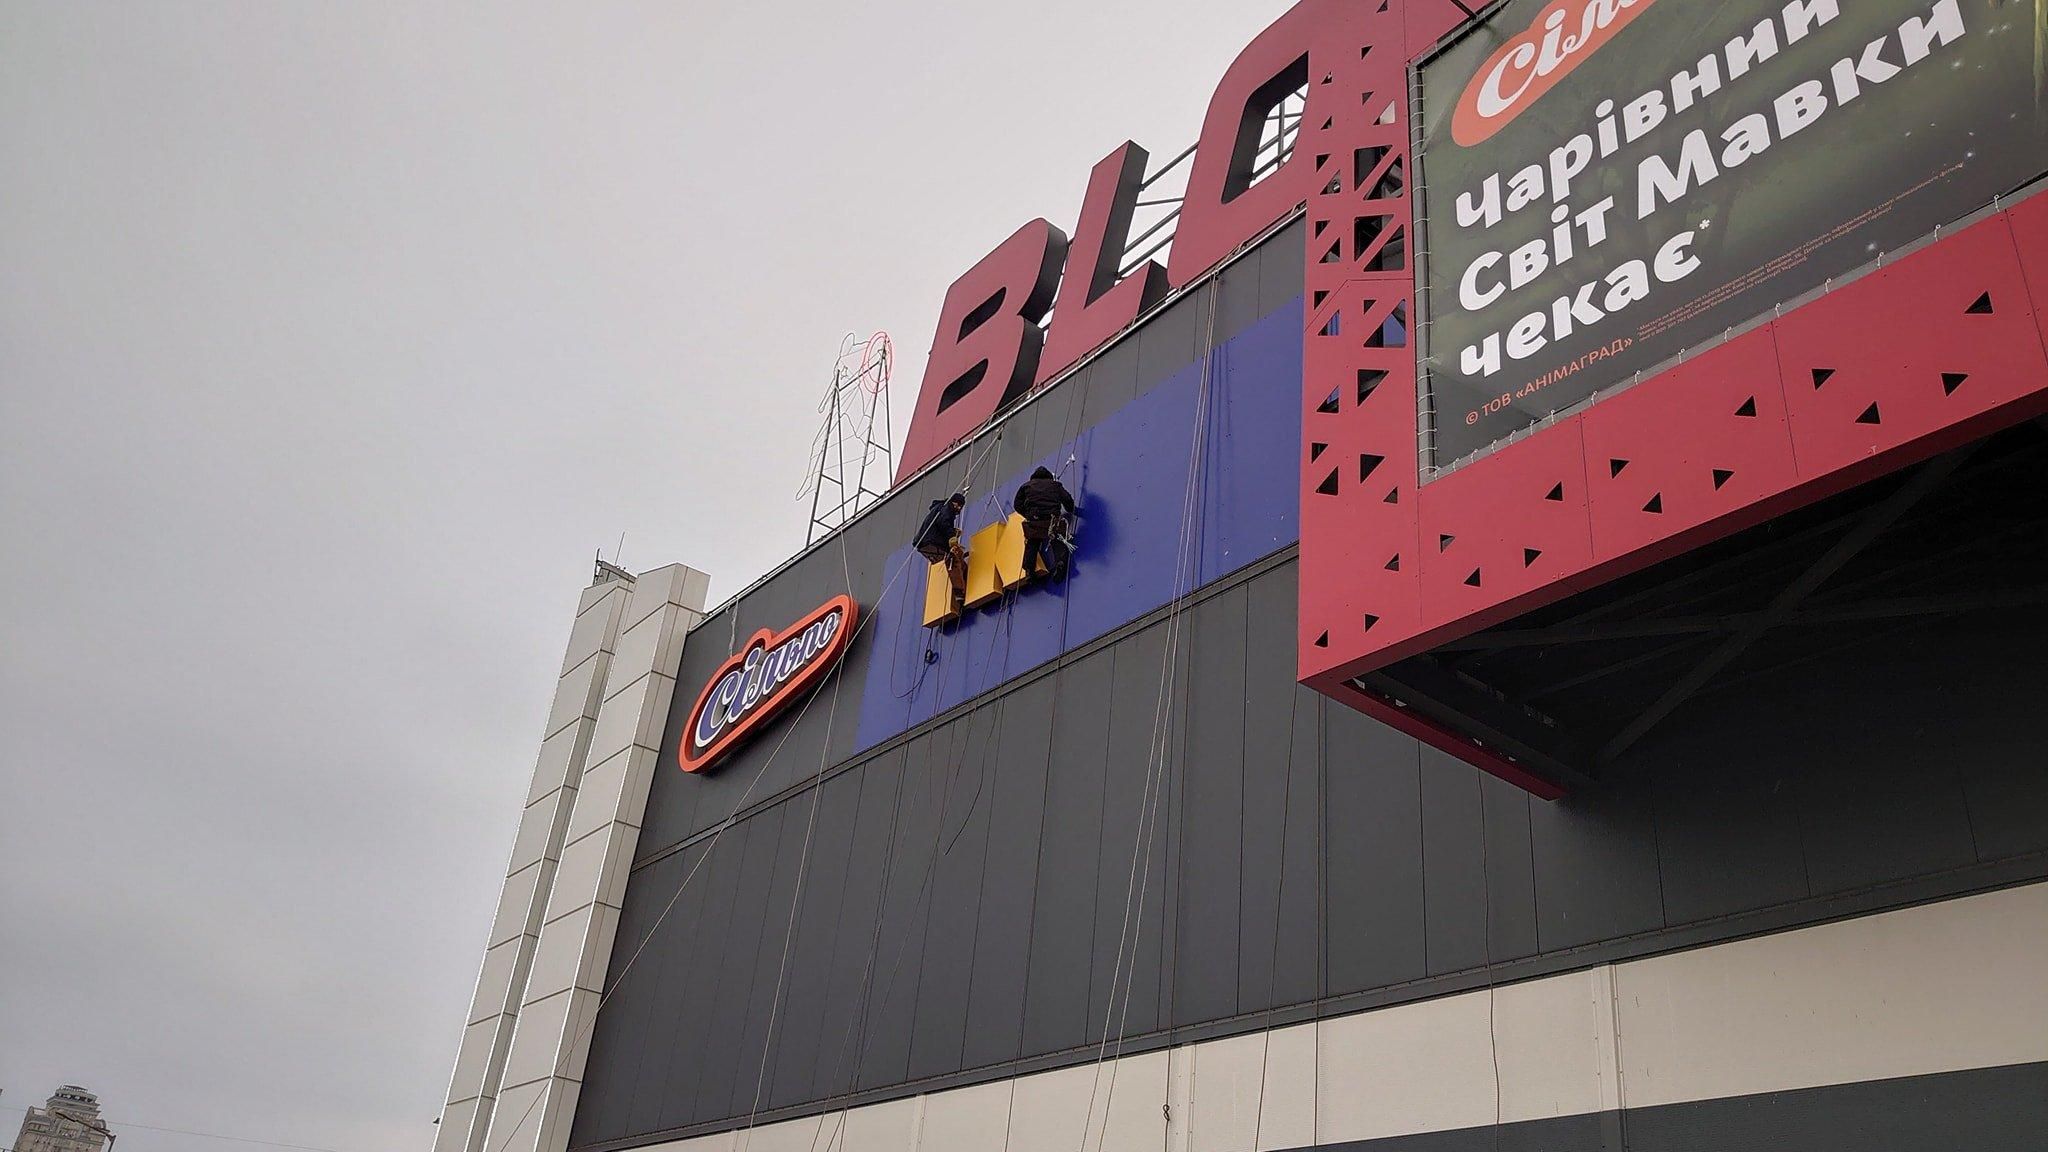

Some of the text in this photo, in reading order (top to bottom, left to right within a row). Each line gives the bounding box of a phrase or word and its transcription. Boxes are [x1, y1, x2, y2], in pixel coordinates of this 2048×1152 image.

[1477, 0, 1637, 118] Сіл
[1459, 195, 1614, 311] Світ
[1638, 0, 1967, 221] Мавки
[1481, 392, 1512, 417] ТОВ
[1515, 337, 1634, 399] «АНІМАГРАД»
[694, 611, 841, 748] Сільпо
